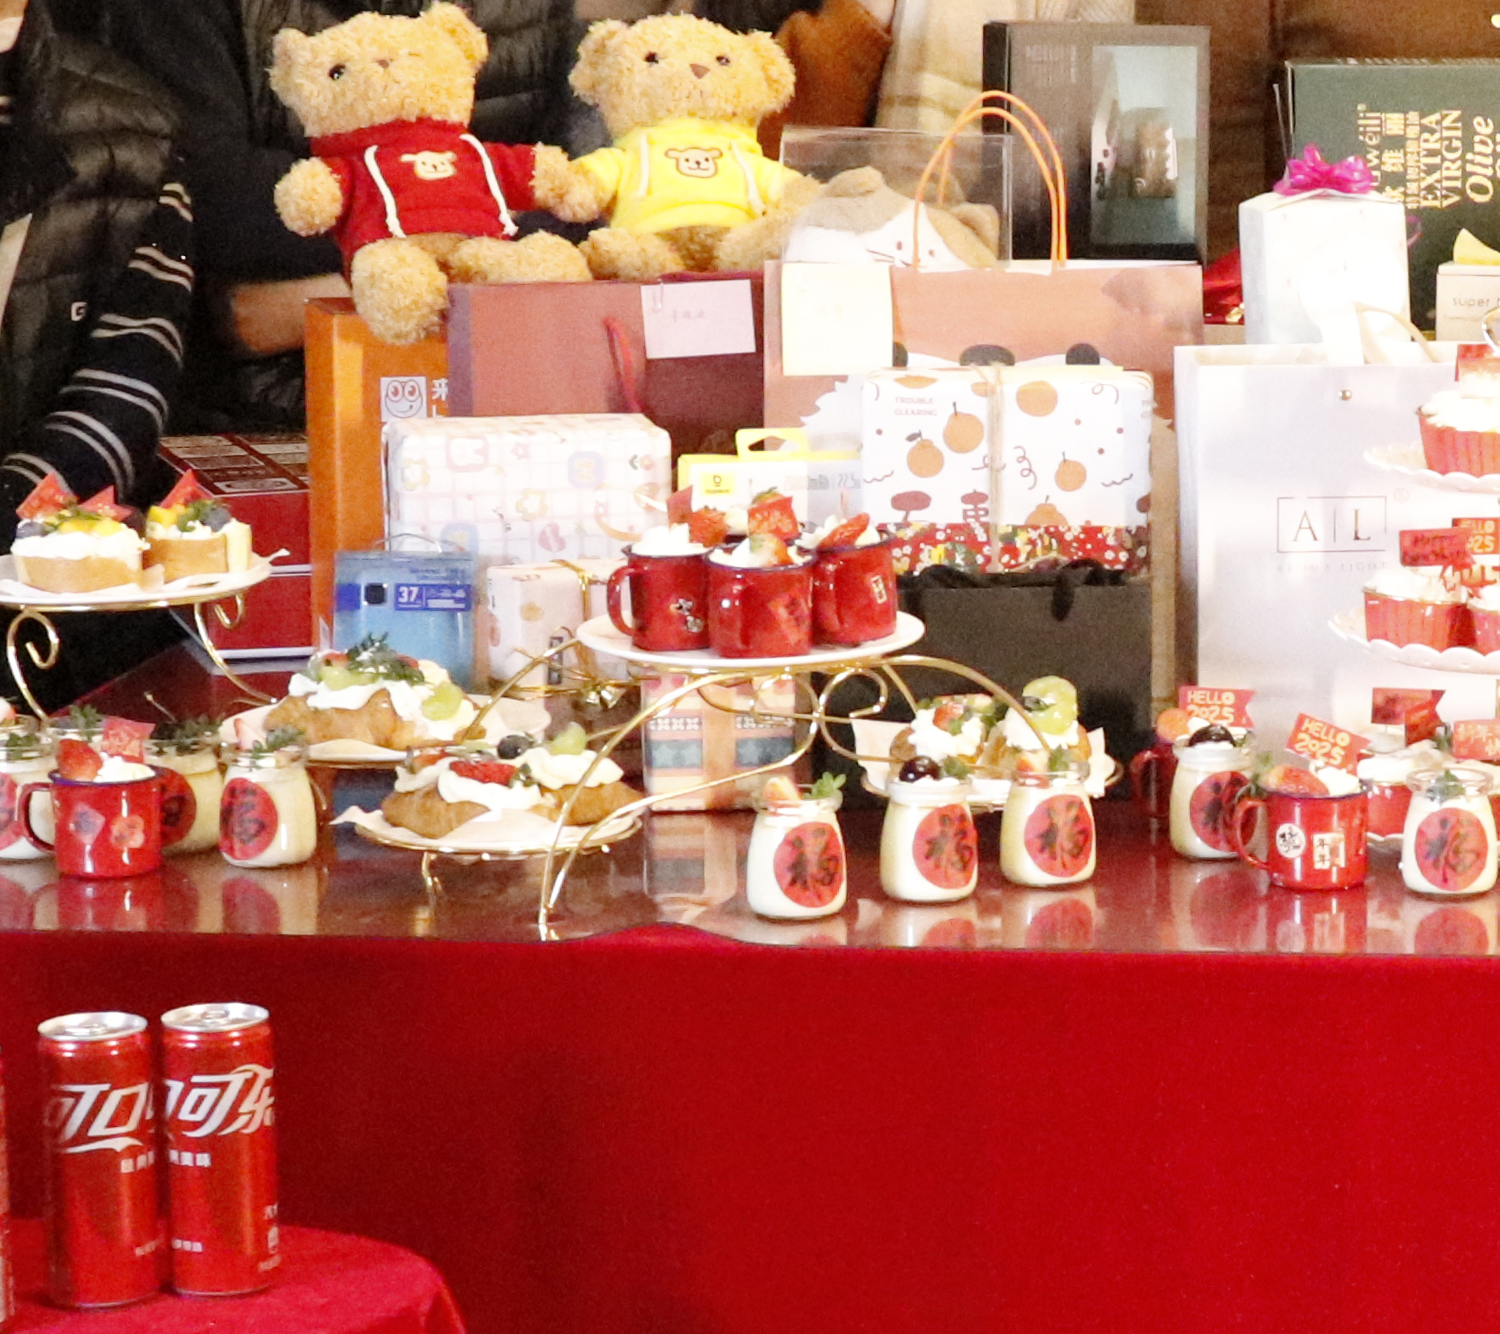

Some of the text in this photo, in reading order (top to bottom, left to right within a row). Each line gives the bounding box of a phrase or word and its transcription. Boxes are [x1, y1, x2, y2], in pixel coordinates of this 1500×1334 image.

[1419, 112, 1438, 208] EXTRA
[1437, 110, 1459, 208] VIRGIN
[1463, 116, 1493, 203] Olive
[398, 587, 419, 603] 37
[1187, 689, 1236, 705] HELLO
[1301, 715, 1351, 747] HELLO
